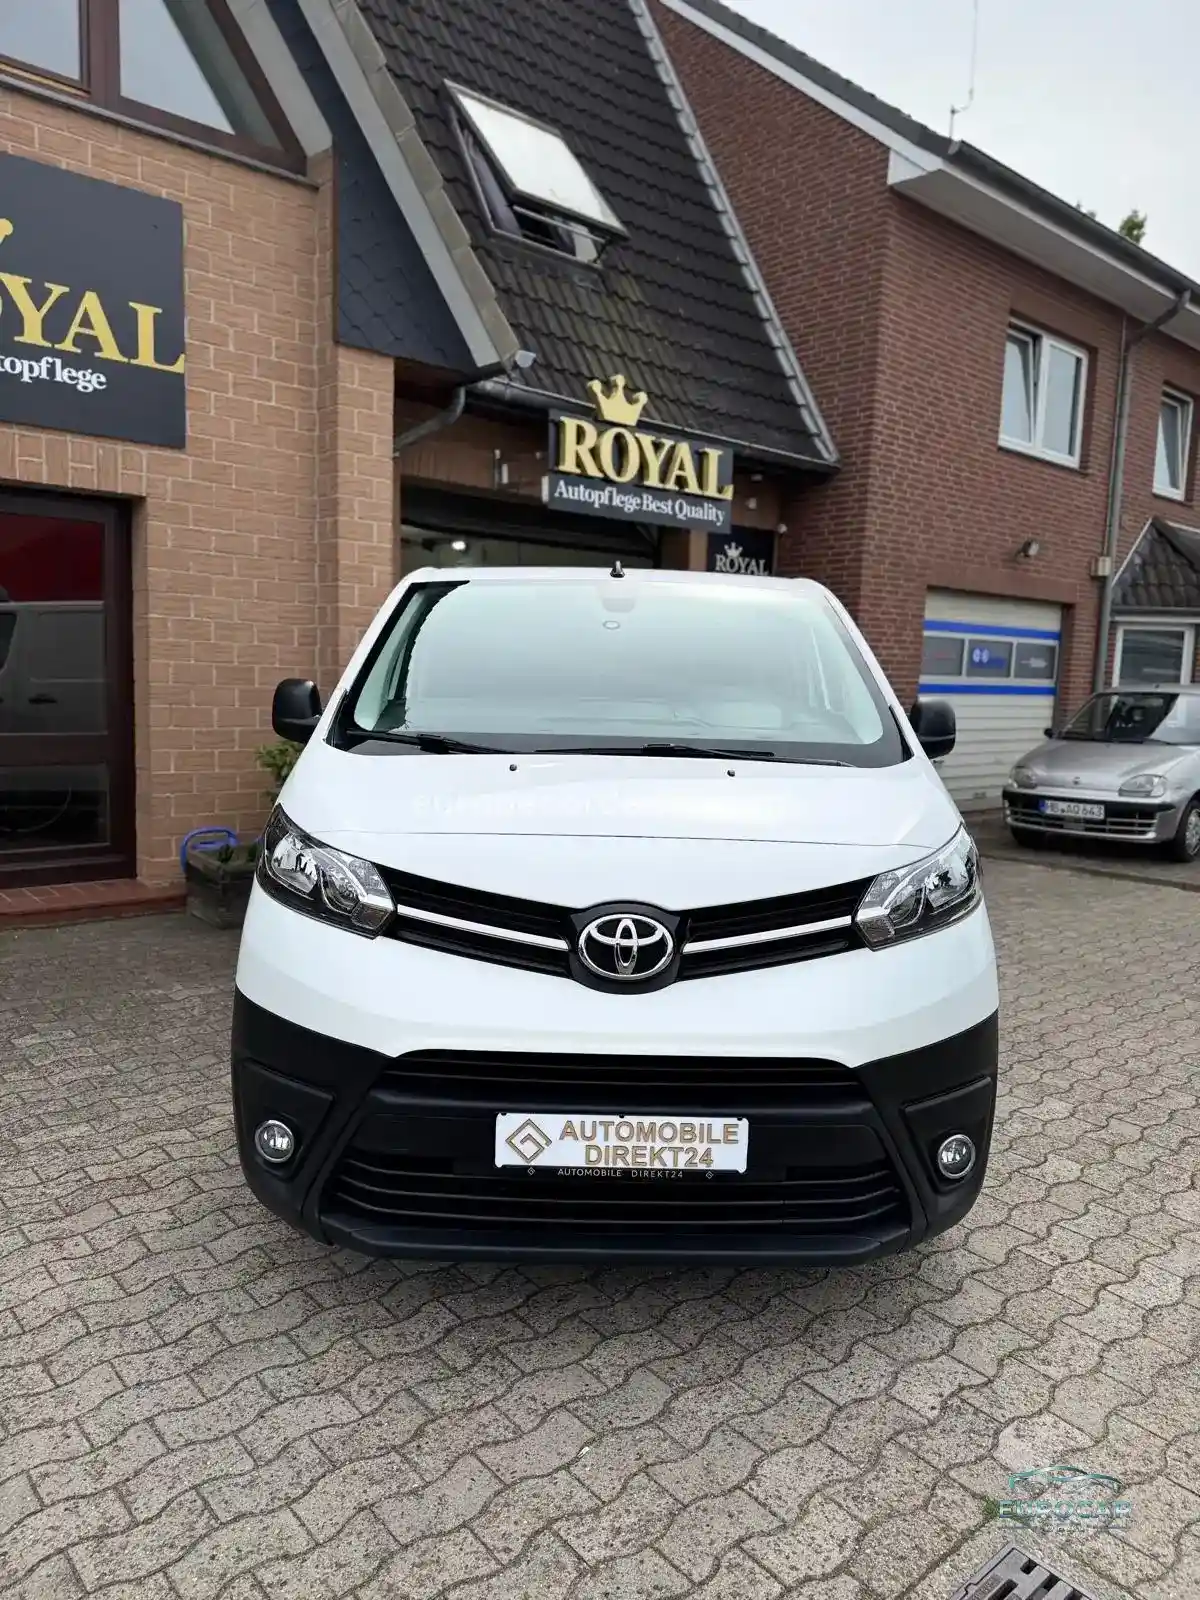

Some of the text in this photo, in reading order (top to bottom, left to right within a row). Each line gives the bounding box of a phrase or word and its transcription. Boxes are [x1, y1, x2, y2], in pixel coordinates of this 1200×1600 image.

[0, 272, 186, 374] YAL
[556, 416, 734, 500] ROYAL
[554, 479, 726, 526] Autopflege Best Quality
[714, 553, 769, 576] ROYAL
[558, 1120, 740, 1145] AUTOMOBILE
[584, 1144, 714, 1168] DIREKT24
[557, 1168, 683, 1179] AUTOMOBILE DIREKT24
